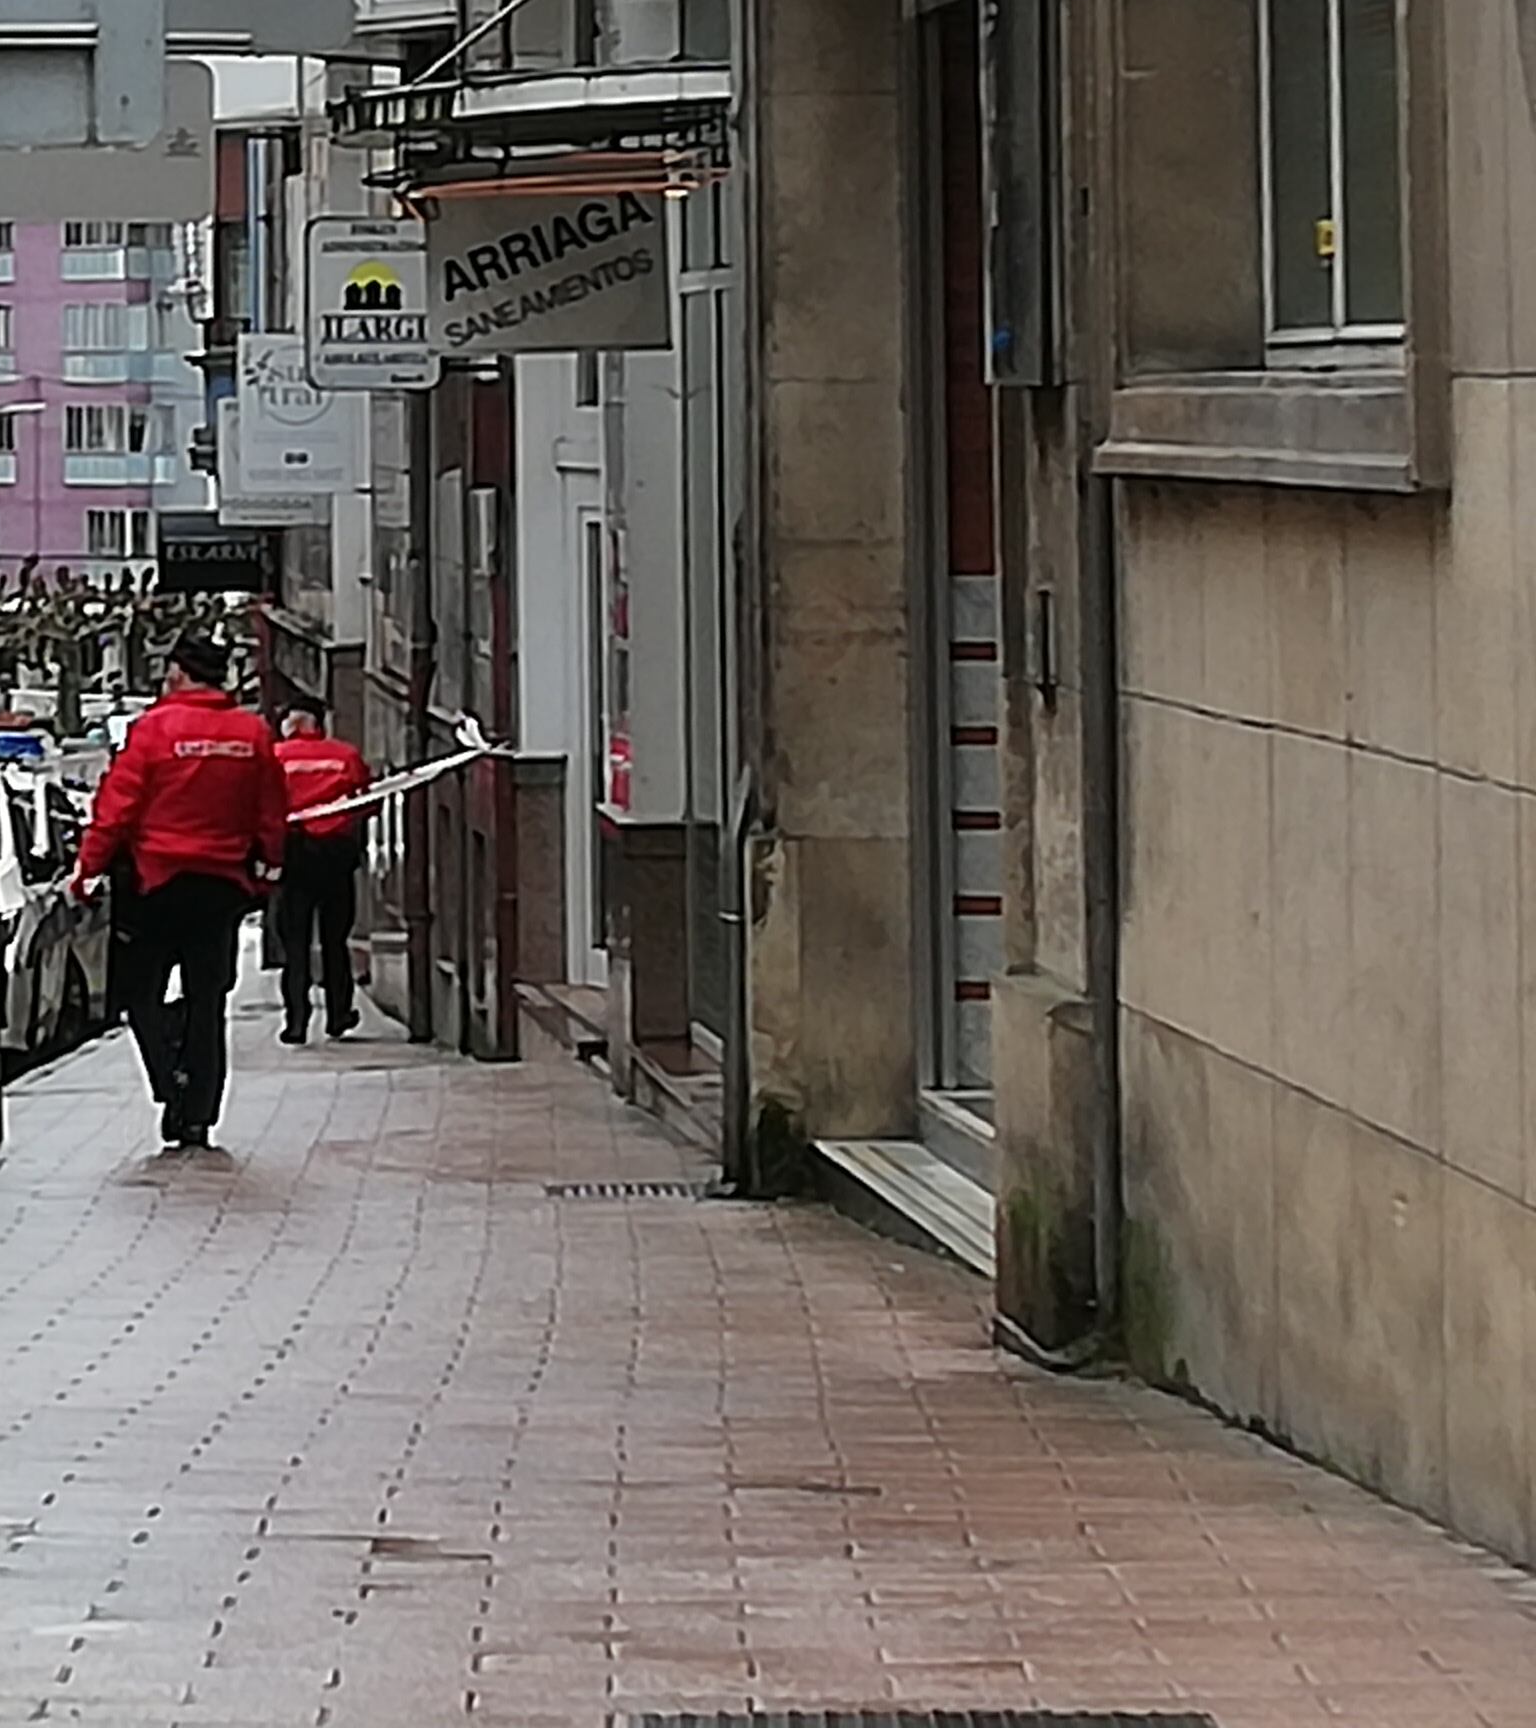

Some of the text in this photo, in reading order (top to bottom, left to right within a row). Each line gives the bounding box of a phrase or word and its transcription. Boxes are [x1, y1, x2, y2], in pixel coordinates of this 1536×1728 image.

[443, 191, 653, 301] ARRIAGA
[322, 315, 428, 345] ILARGI
[444, 248, 654, 348] SANEAMIENTOS
